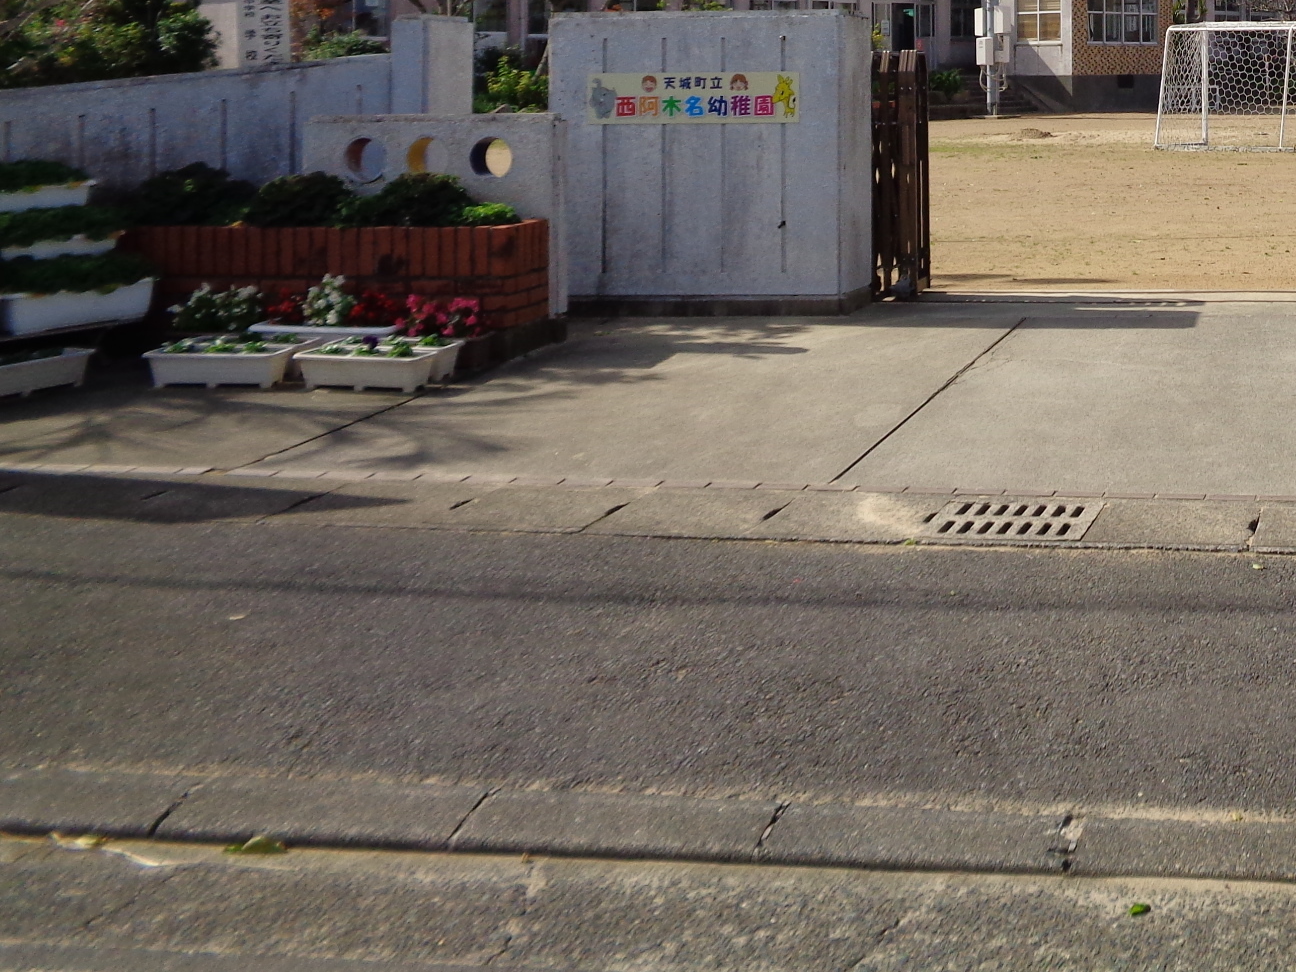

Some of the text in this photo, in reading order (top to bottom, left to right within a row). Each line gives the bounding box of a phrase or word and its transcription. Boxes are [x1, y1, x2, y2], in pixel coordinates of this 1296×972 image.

[663, 77, 723, 90] 天城町立
[615, 95, 775, 117] 西阿木名幼稚園
